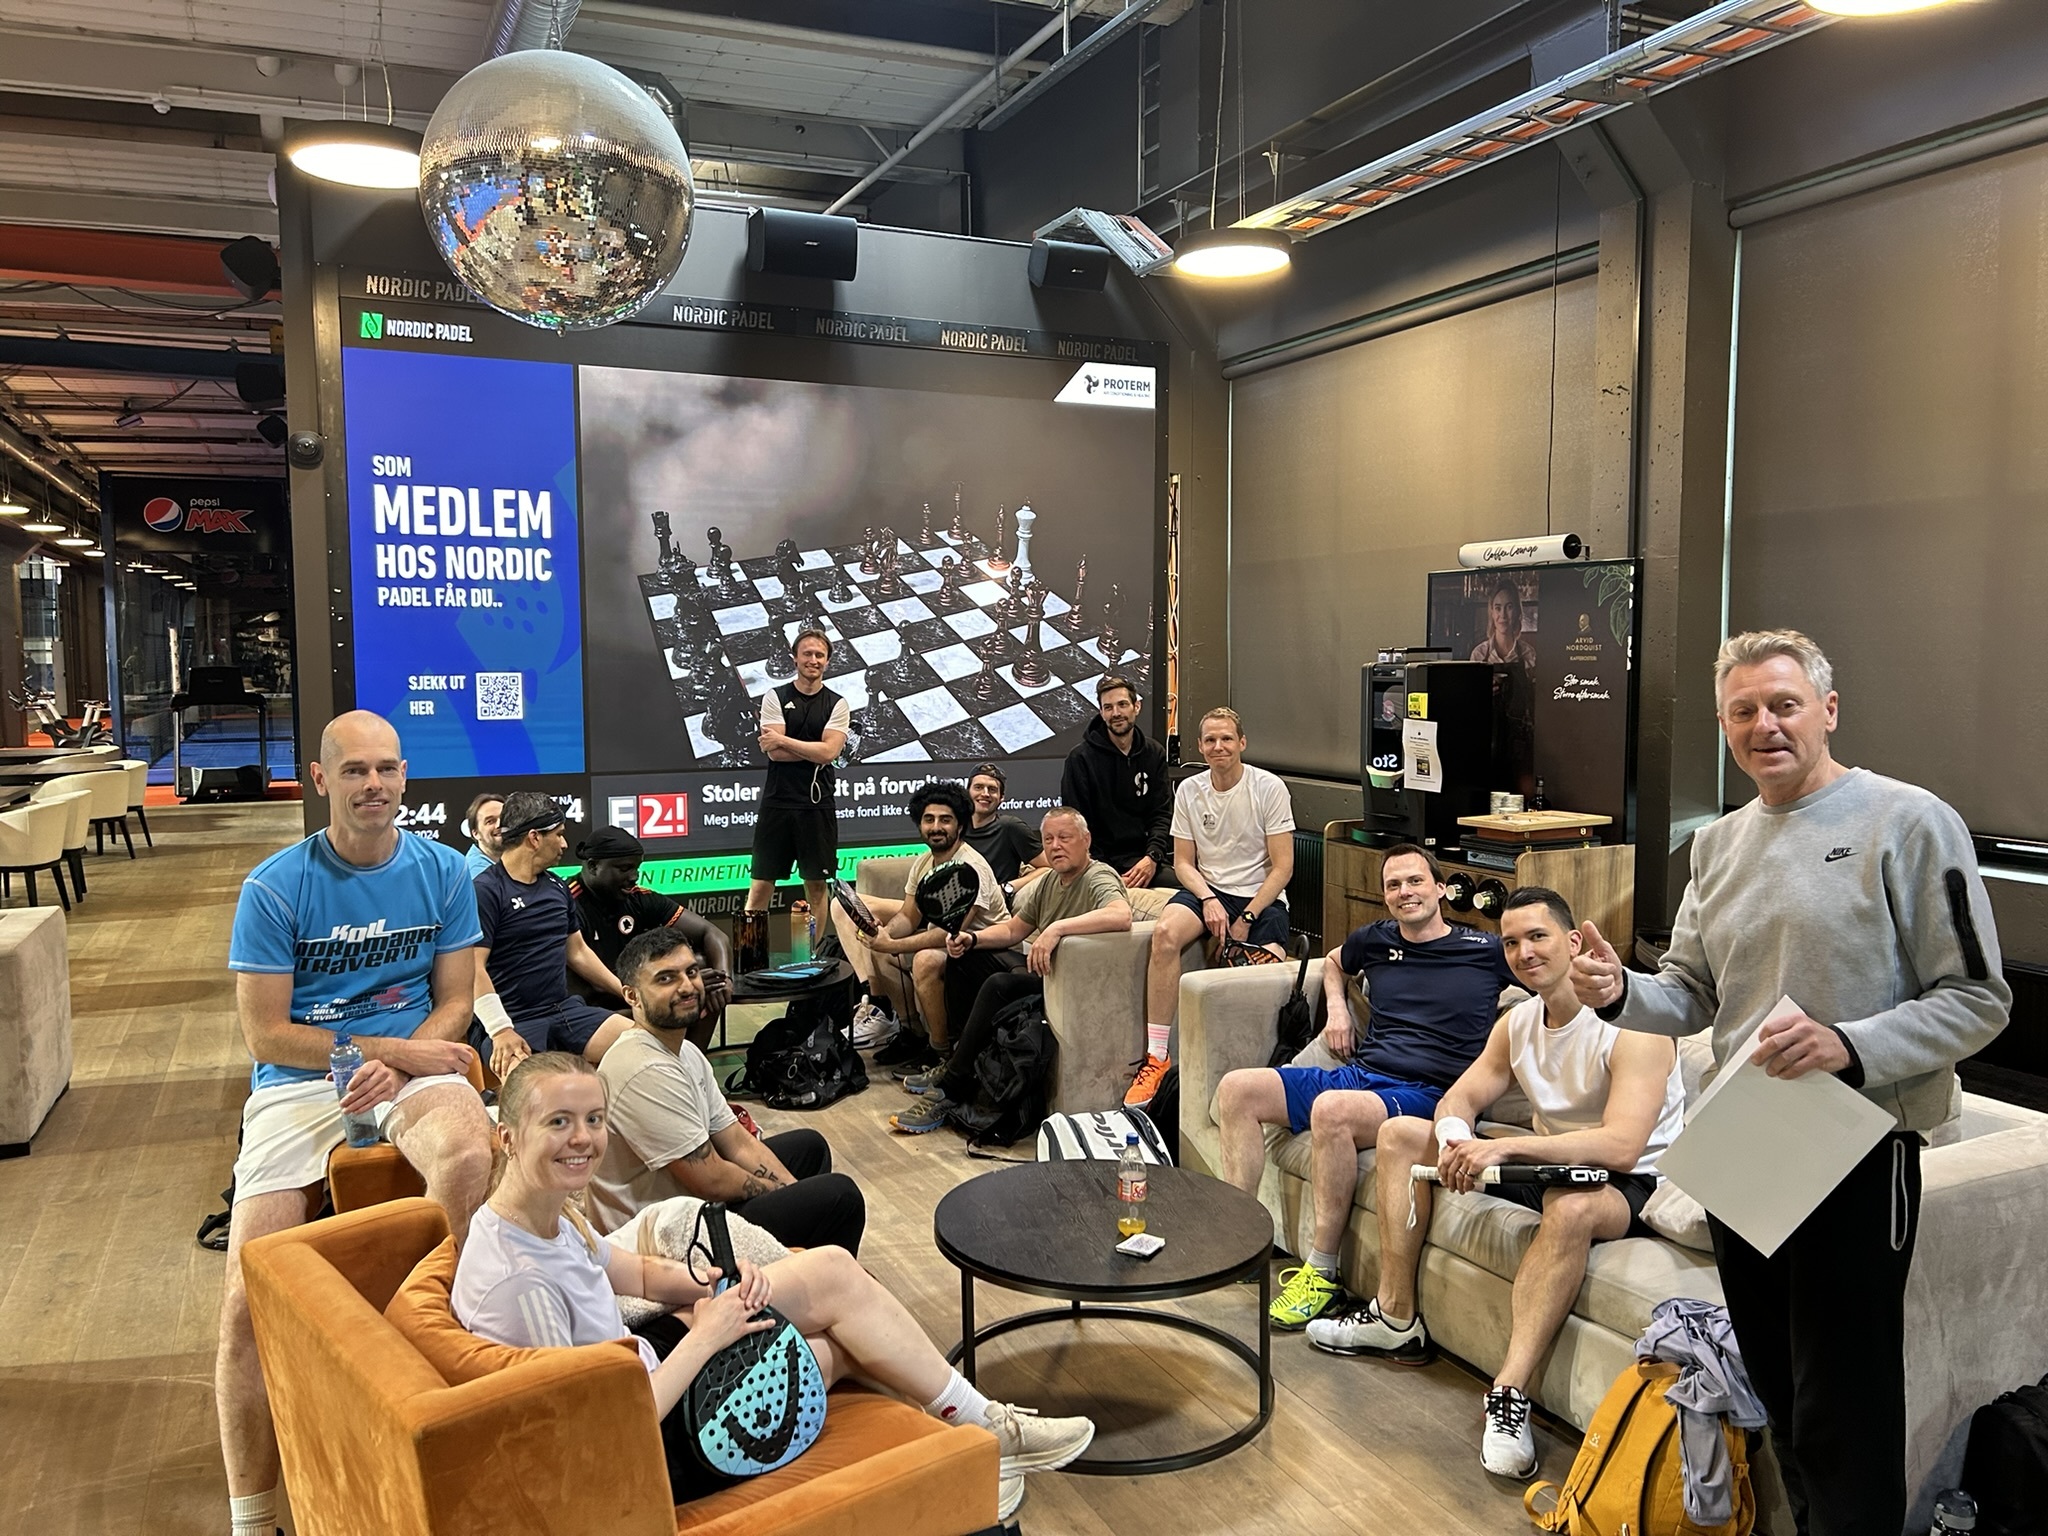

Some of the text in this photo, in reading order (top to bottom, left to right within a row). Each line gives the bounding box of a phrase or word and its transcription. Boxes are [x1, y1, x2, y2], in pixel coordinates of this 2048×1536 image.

[366, 275, 485, 303] NORDIC PADE
[673, 305, 775, 330] NORDIC PADEL
[387, 319, 473, 342] NORDIC PADEL
[816, 317, 910, 342] NORDIC PADEL
[941, 329, 1028, 353] NORDIC PADEL
[1057, 339, 1139, 362] NORDIC PADEL
[1103, 378, 1151, 392] PROTERM
[372, 455, 412, 477] SOM
[190, 498, 220, 507] pepsi
[373, 484, 553, 539] MEDLEM
[184, 508, 255, 534] MAX
[376, 543, 553, 582] HOS NORDIC
[377, 586, 432, 607] PADEL
[434, 582, 468, 607] FÅR
[408, 675, 466, 690] SJEKK UT
[409, 700, 434, 715] HER
[702, 782, 761, 804] Stoler
[853, 776, 876, 801] på
[394, 803, 447, 826] 2:44
[998, 798, 1024, 810] orfor
[1024, 800, 1035, 809] er
[1036, 797, 1052, 809] det
[704, 814, 729, 828] Meg
[731, 811, 759, 827] bekje
[857, 805, 880, 817] fond
[882, 804, 902, 816] ikke
[671, 862, 752, 884] PRIMETIM
[687, 894, 740, 915] NORDIC
